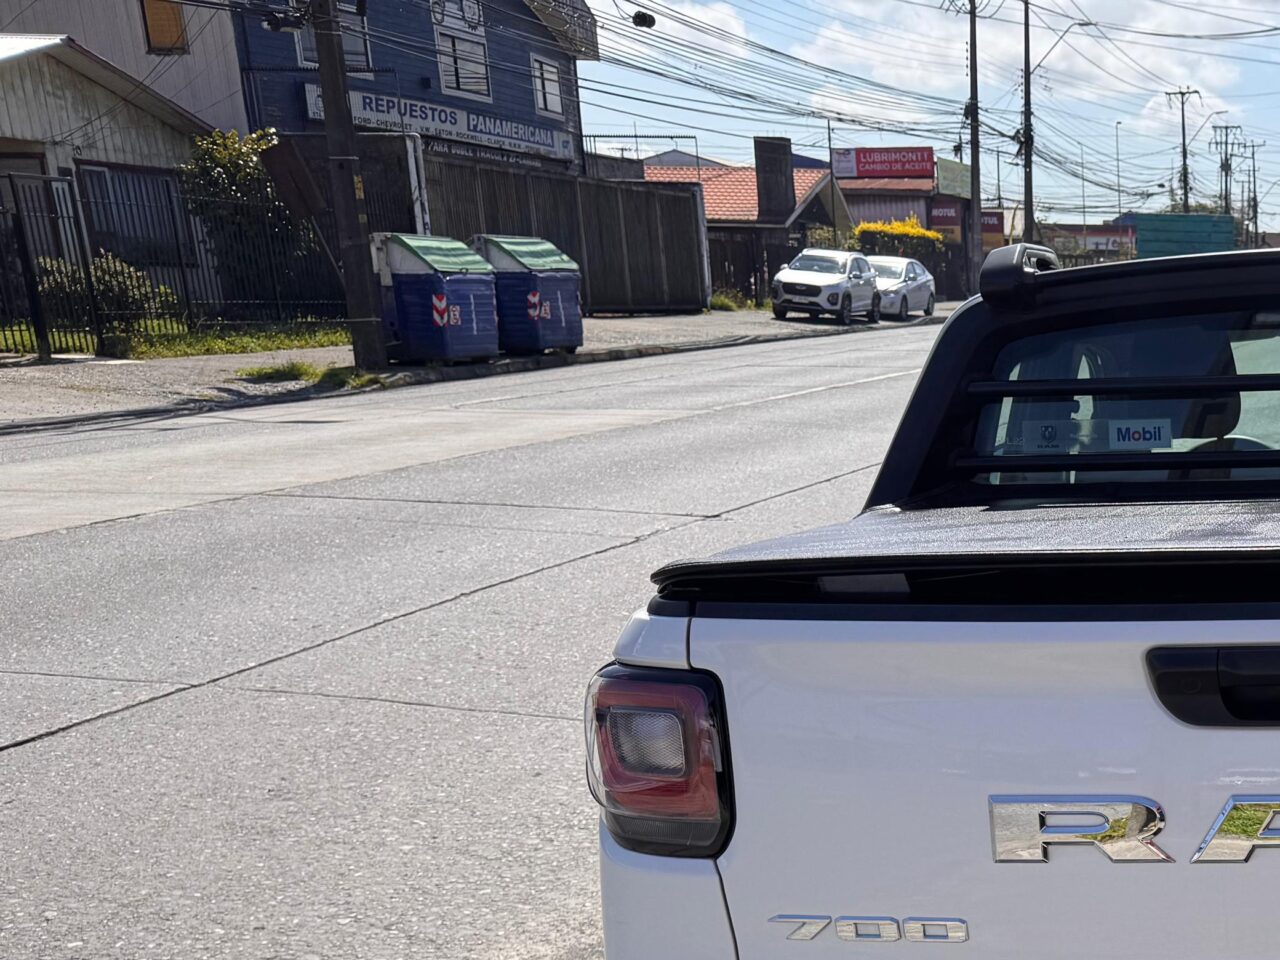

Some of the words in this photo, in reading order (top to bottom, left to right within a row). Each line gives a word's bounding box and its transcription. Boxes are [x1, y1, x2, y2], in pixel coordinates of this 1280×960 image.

[362, 95, 458, 125] REPUESTOS
[469, 113, 554, 146] PANAMERICANA
[376, 120, 412, 131] CHEVROET
[859, 162, 890, 171] CAMBIO
[892, 162, 902, 170] DE
[904, 161, 931, 170] ACEITE
[931, 207, 956, 217] MOTUL
[1116, 426, 1162, 442] Mobil
[767, 914, 970, 943] 700
